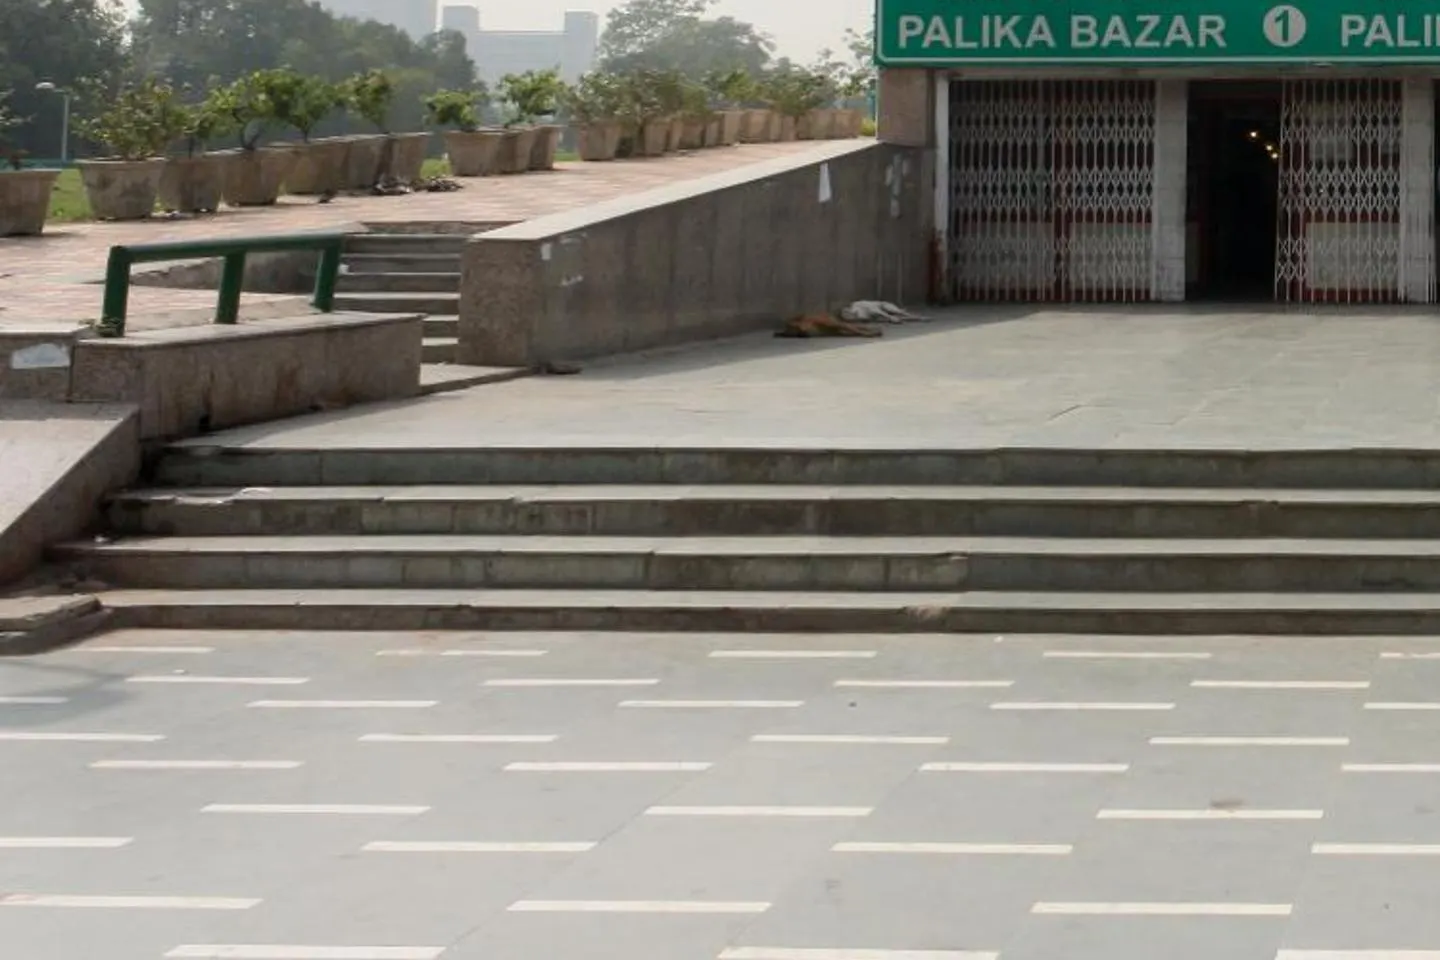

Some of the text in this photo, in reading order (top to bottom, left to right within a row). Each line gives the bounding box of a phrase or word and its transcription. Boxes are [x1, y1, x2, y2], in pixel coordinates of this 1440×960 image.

[899, 15, 1227, 48] PALIKA BAZAR
[1273, 8, 1290, 44] 1
